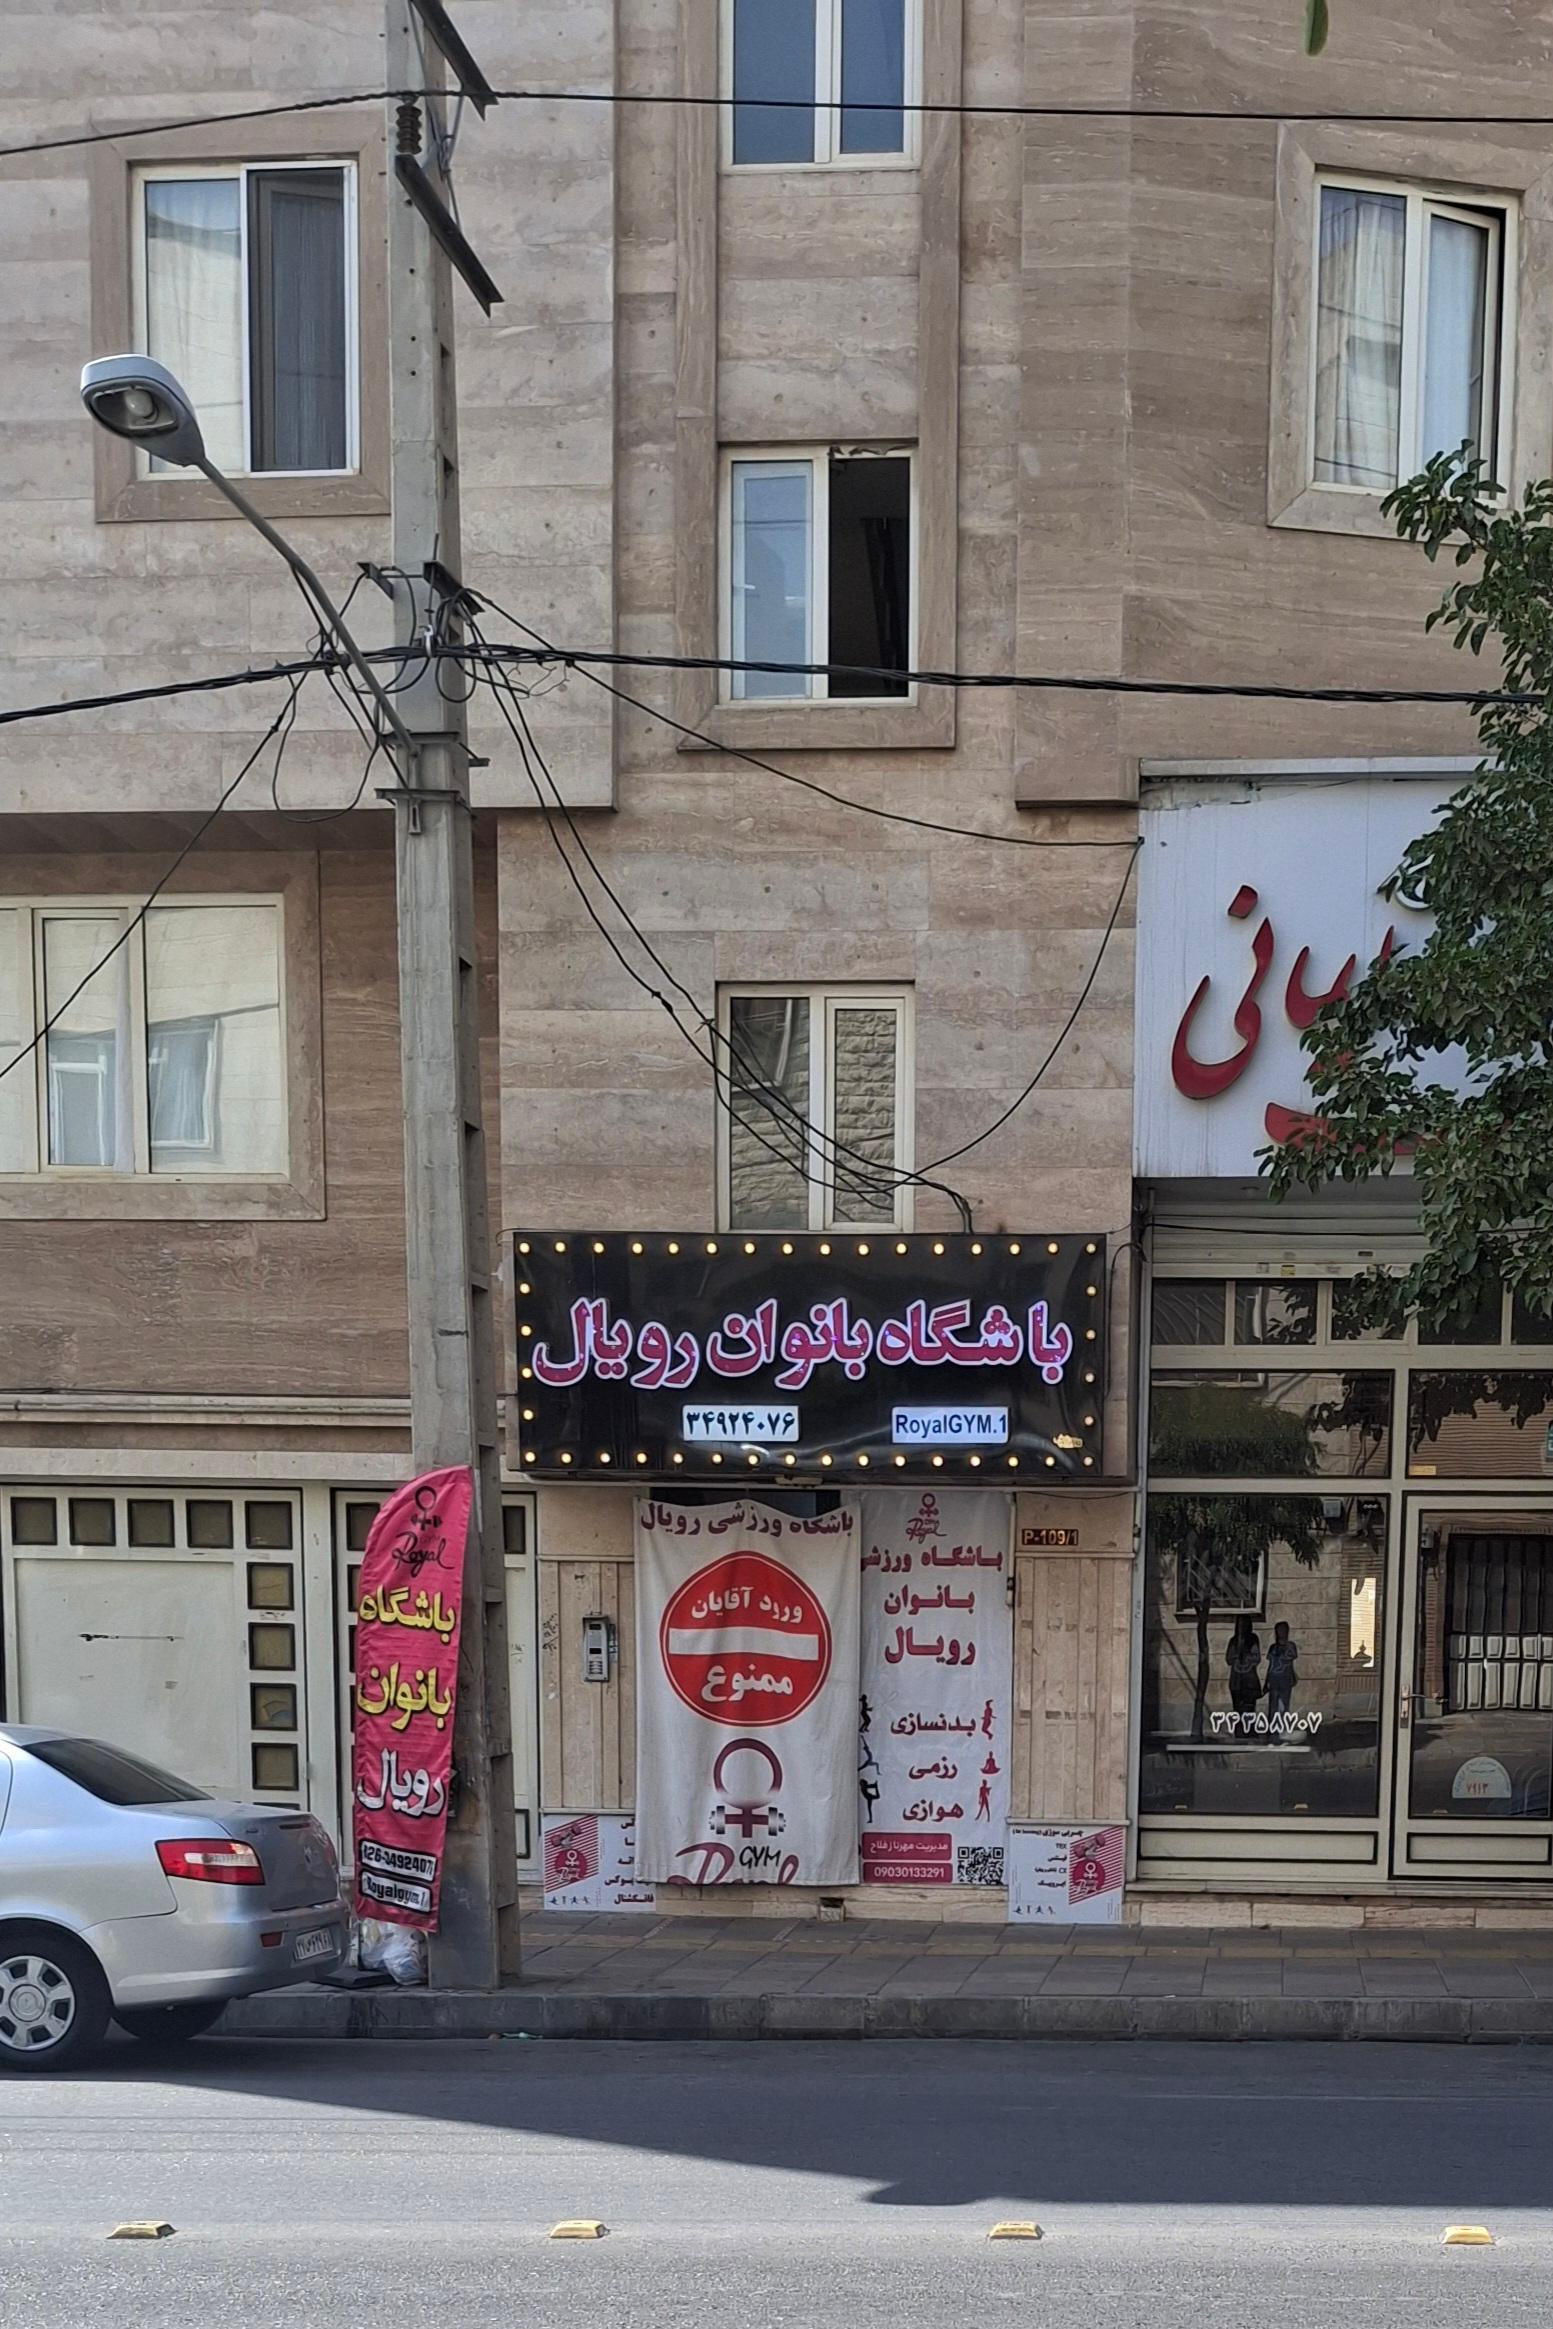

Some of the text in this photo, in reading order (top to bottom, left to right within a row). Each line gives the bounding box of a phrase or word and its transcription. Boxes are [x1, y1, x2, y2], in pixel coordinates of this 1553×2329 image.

[532, 1297, 1073, 1390] باشگاه بانوان رویال
[686, 1411, 796, 1436] ۳۴۹۲۴۰۷۶
[895, 1413, 1007, 1439] RoyalGYM.1
[641, 1502, 702, 1536] رویال
[708, 1501, 783, 1537] ورزشی
[1023, 1530, 1078, 1545] P-109/1
[861, 1545, 1003, 1573] باشگاه ورزش
[359, 1584, 456, 1644] باشگاه
[691, 1586, 803, 1624] ورود آقایان
[884, 1584, 976, 1615] بانوان
[885, 1626, 977, 1666] رویال
[357, 1662, 452, 1730] بانوان
[701, 1663, 794, 1702] ممنوع
[890, 1712, 977, 1737] بدنسازی
[1210, 1711, 1323, 1734] ۳۴۳۵۸۷۰۷
[356, 1747, 445, 1817] رویال
[909, 1756, 958, 1779] رزمی
[902, 1799, 964, 1822] هوازی
[739, 1845, 782, 1869] GYM
[873, 1866, 945, 1878] 09030133291
